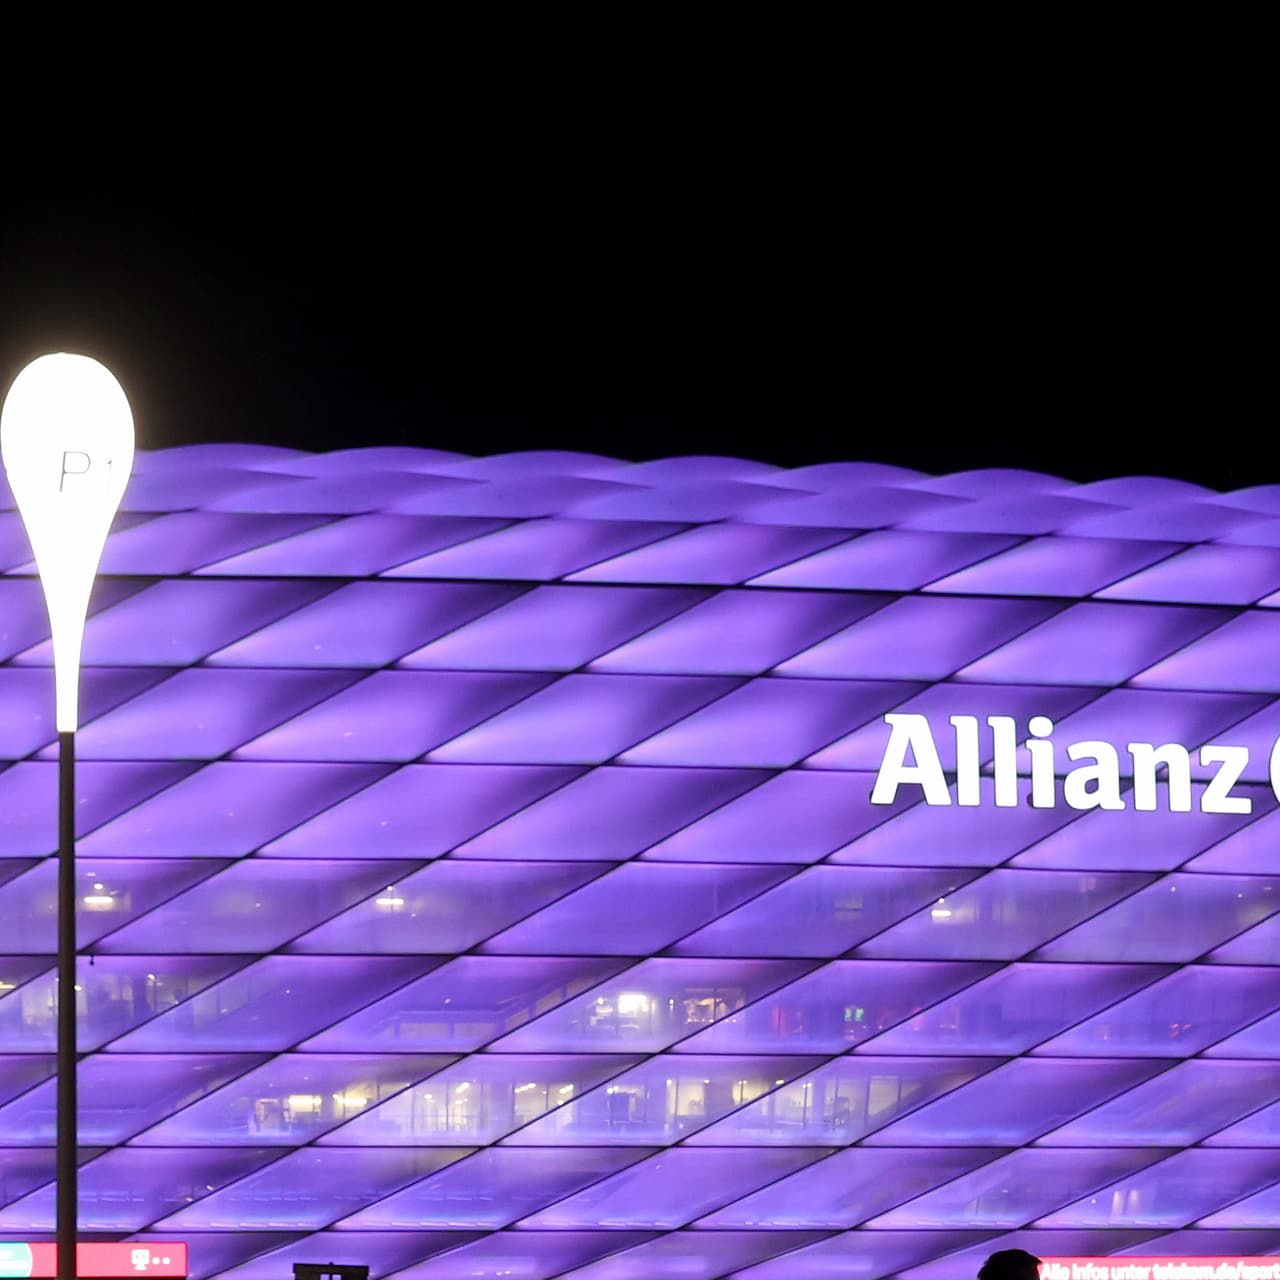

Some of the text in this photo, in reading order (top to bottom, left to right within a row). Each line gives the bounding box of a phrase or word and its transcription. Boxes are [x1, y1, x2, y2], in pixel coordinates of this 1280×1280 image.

[870, 713, 1252, 815] Allianz
[1040, 1263, 1070, 1280] Alle
[1072, 1263, 1109, 1280] Infos
[1111, 1264, 1151, 1280] unter
